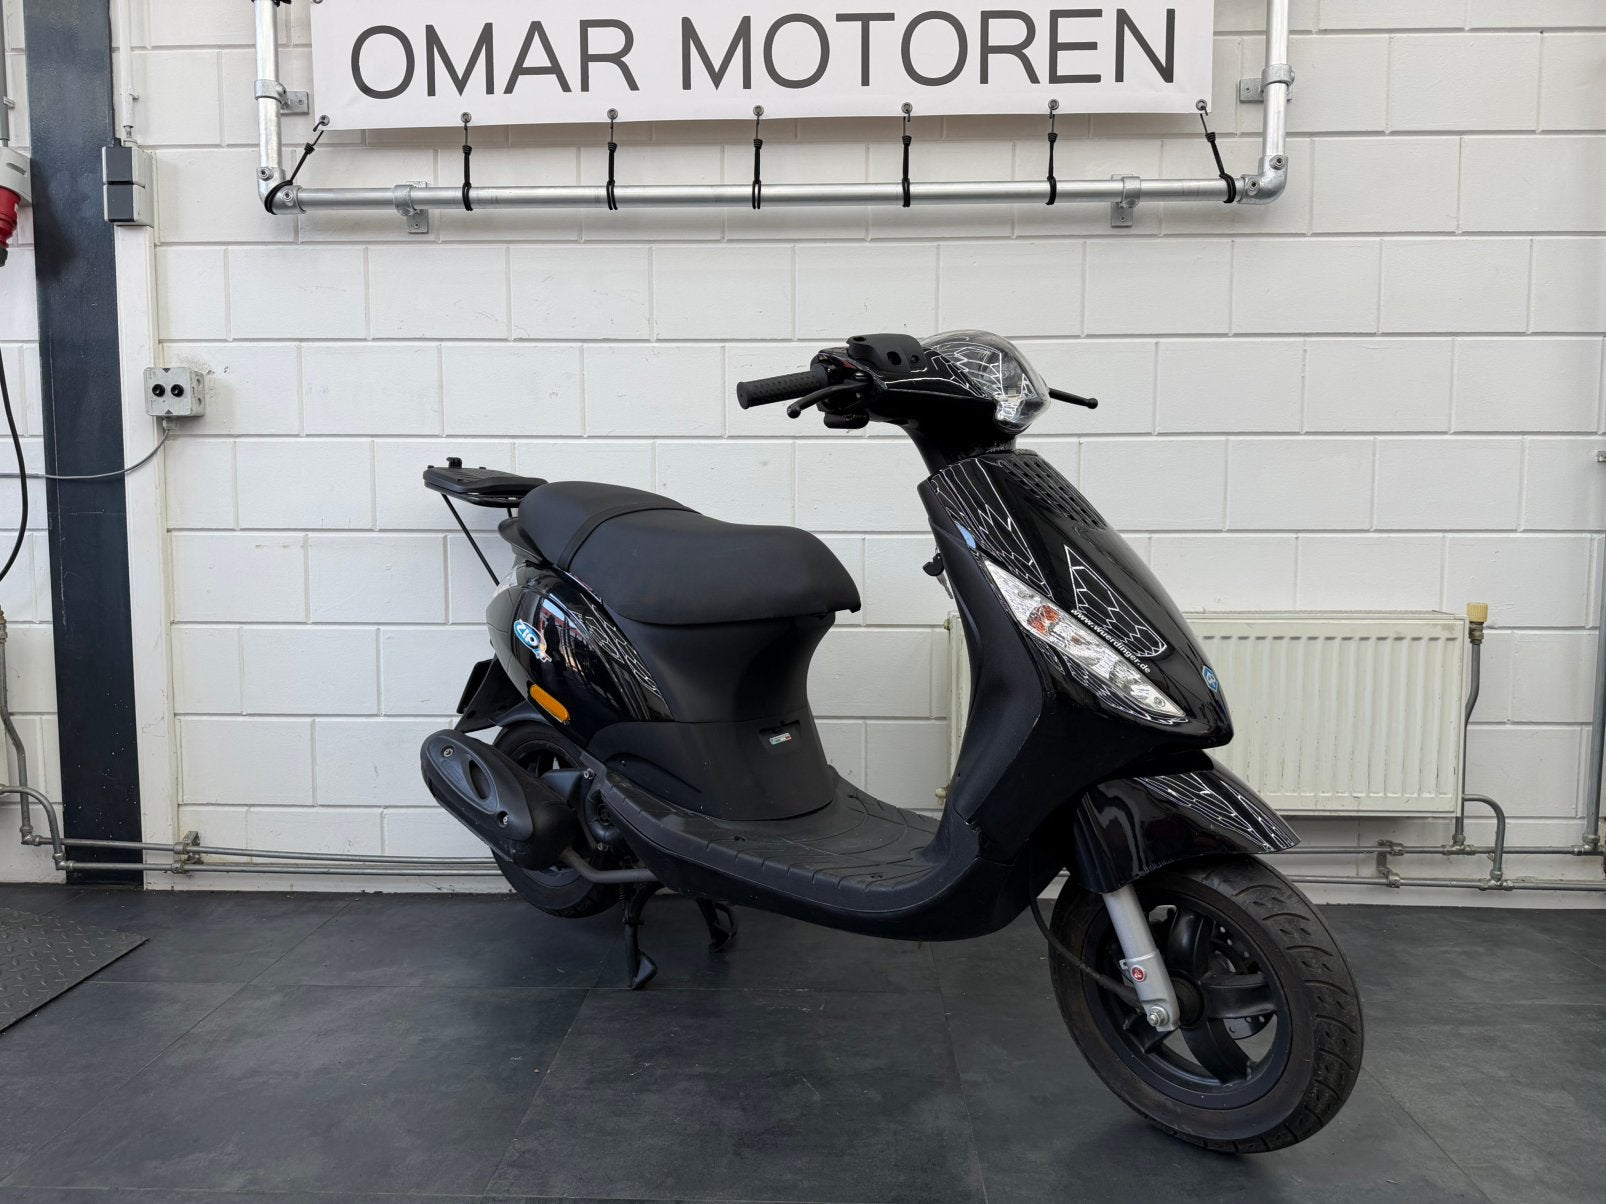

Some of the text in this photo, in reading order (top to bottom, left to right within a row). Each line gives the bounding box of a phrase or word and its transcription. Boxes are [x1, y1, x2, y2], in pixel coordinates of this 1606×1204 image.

[351, 9, 1175, 99] OMAR MOTOREN
[1071, 609, 1151, 674] www.wuerdinger.de
